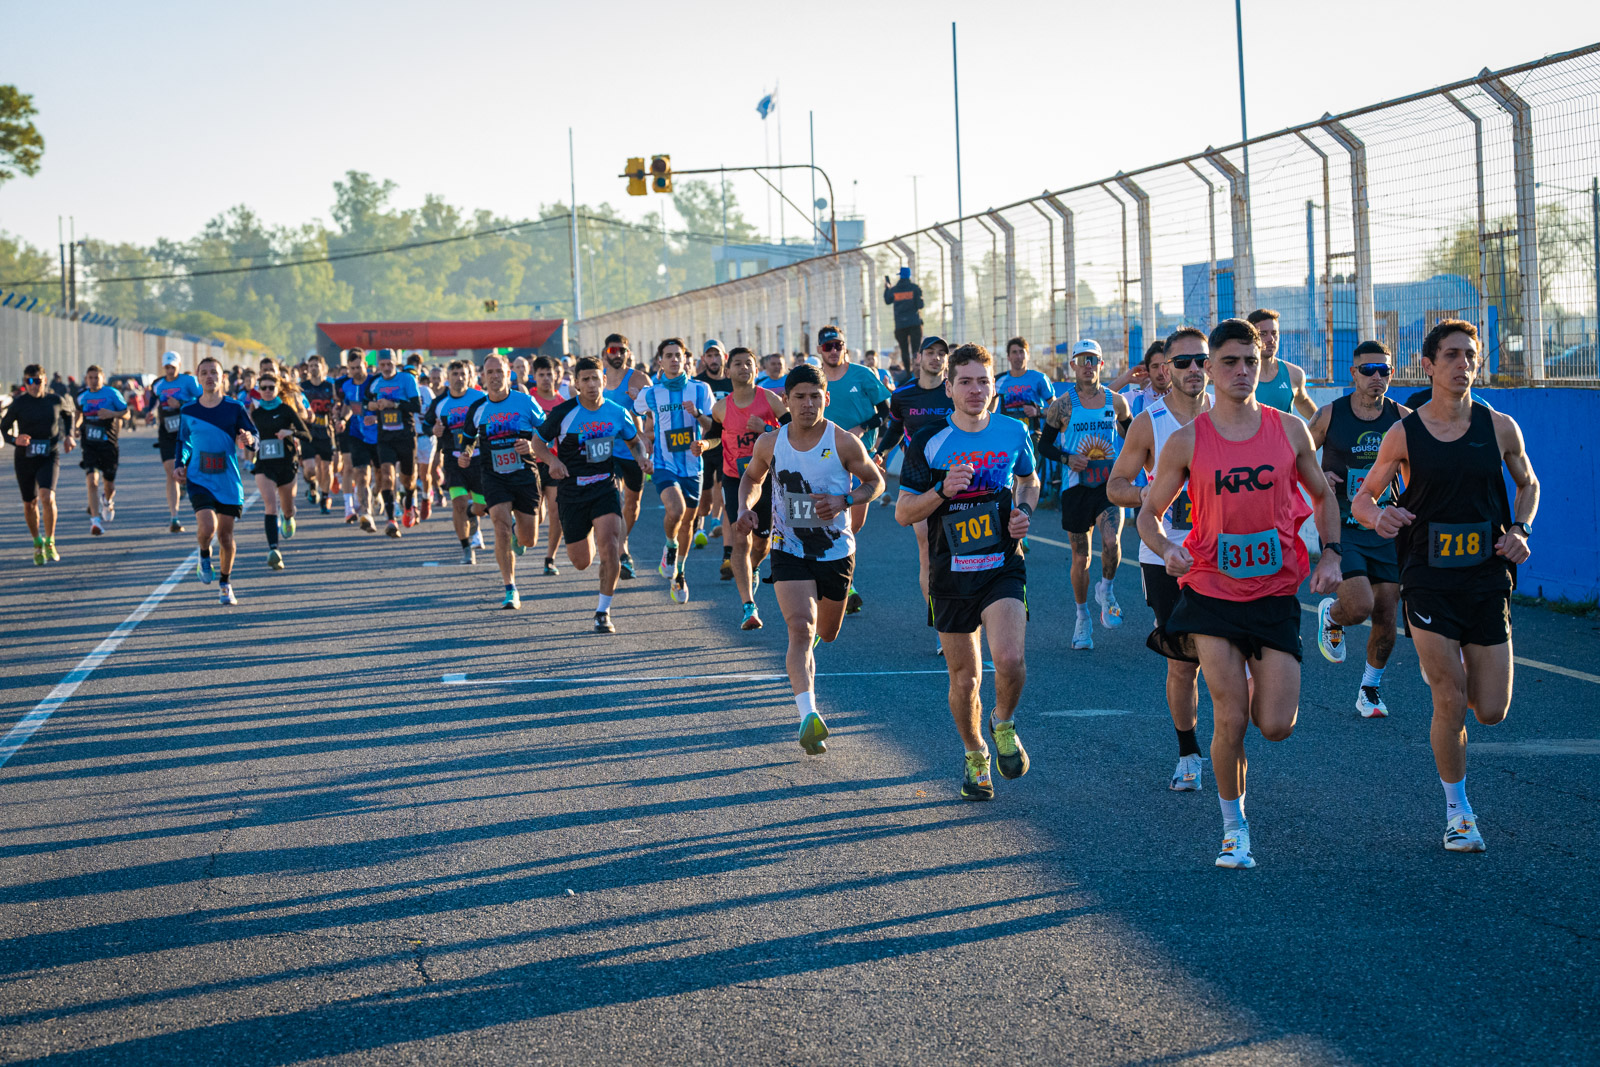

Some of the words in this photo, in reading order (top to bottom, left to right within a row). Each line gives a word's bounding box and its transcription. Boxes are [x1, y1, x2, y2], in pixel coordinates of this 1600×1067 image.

[659, 402, 685, 412] GUEPA
[1073, 422, 1089, 432] TODO
[1090, 421, 1097, 430] ES
[670, 432, 691, 446] 705
[737, 431, 760, 449] KR
[31, 444, 47, 454] 167
[265, 444, 277, 455] 21
[591, 441, 611, 458] 105
[496, 452, 517, 467] 359
[971, 450, 1008, 469] 500
[1215, 464, 1275, 496] KRC
[793, 500, 818, 519] 17
[955, 514, 993, 544] 707
[1439, 532, 1480, 557] 718
[1228, 541, 1271, 569] 313
